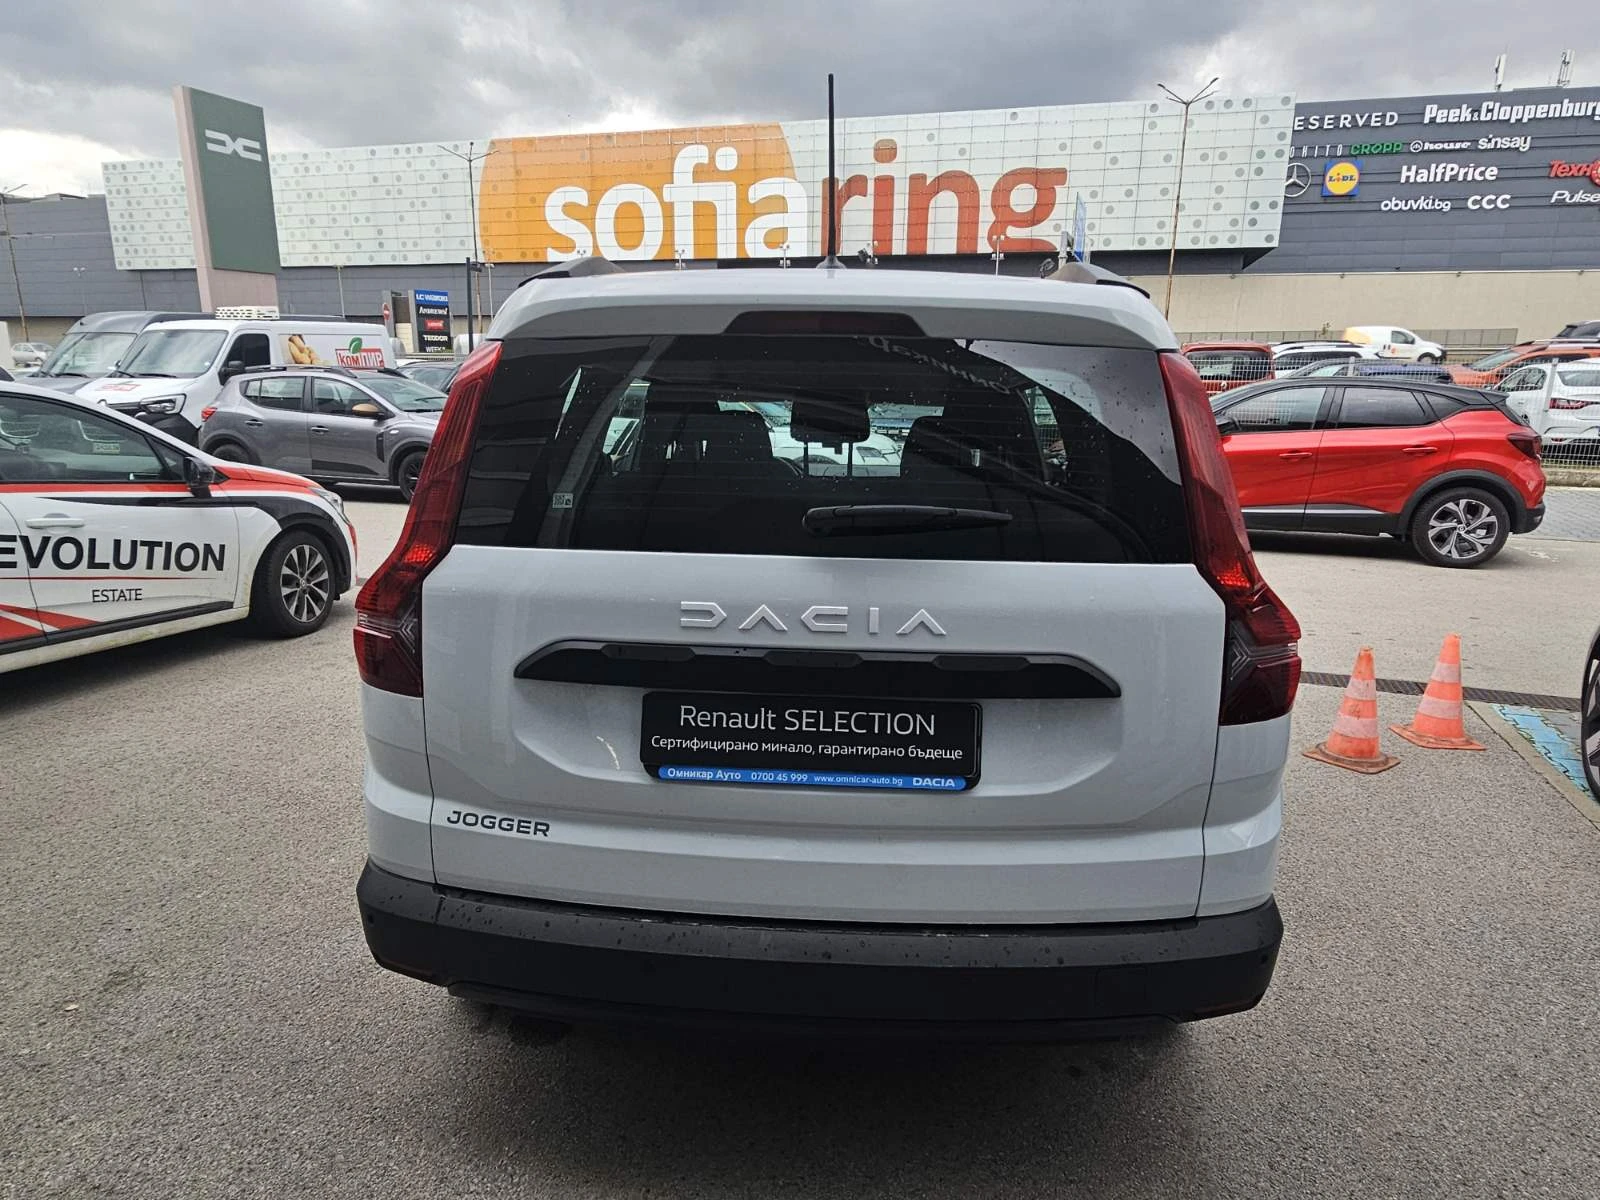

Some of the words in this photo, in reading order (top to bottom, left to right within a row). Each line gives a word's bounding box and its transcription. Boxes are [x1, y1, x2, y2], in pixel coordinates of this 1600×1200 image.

[1294, 112, 1399, 130] ESERVED
[1351, 142, 1402, 155] CROPP
[1478, 135, 1531, 151] sinsay
[1400, 163, 1498, 183] HalfPrice
[1381, 196, 1451, 211] obuvki.bg
[1467, 194, 1511, 209] CCC
[0, 535, 225, 571] EVOLUTION
[92, 588, 143, 602] ESTATE
[680, 601, 947, 635] DACIA
[680, 705, 776, 730] Renault
[784, 709, 935, 735] SELECTION
[651, 735, 758, 752] Сертифицирано
[761, 741, 815, 755] минало,
[818, 744, 904, 758] гарантирано
[908, 745, 963, 760] бъдеще
[667, 768, 713, 779] Омникар
[715, 769, 741, 780] Ауто
[751, 772, 774, 781] 0700
[776, 773, 788, 781] 45
[790, 774, 808, 782] 999
[814, 775, 903, 785] www.omnicar-auto.bg
[912, 776, 955, 787] DACIA
[447, 810, 550, 837] JOGGER
